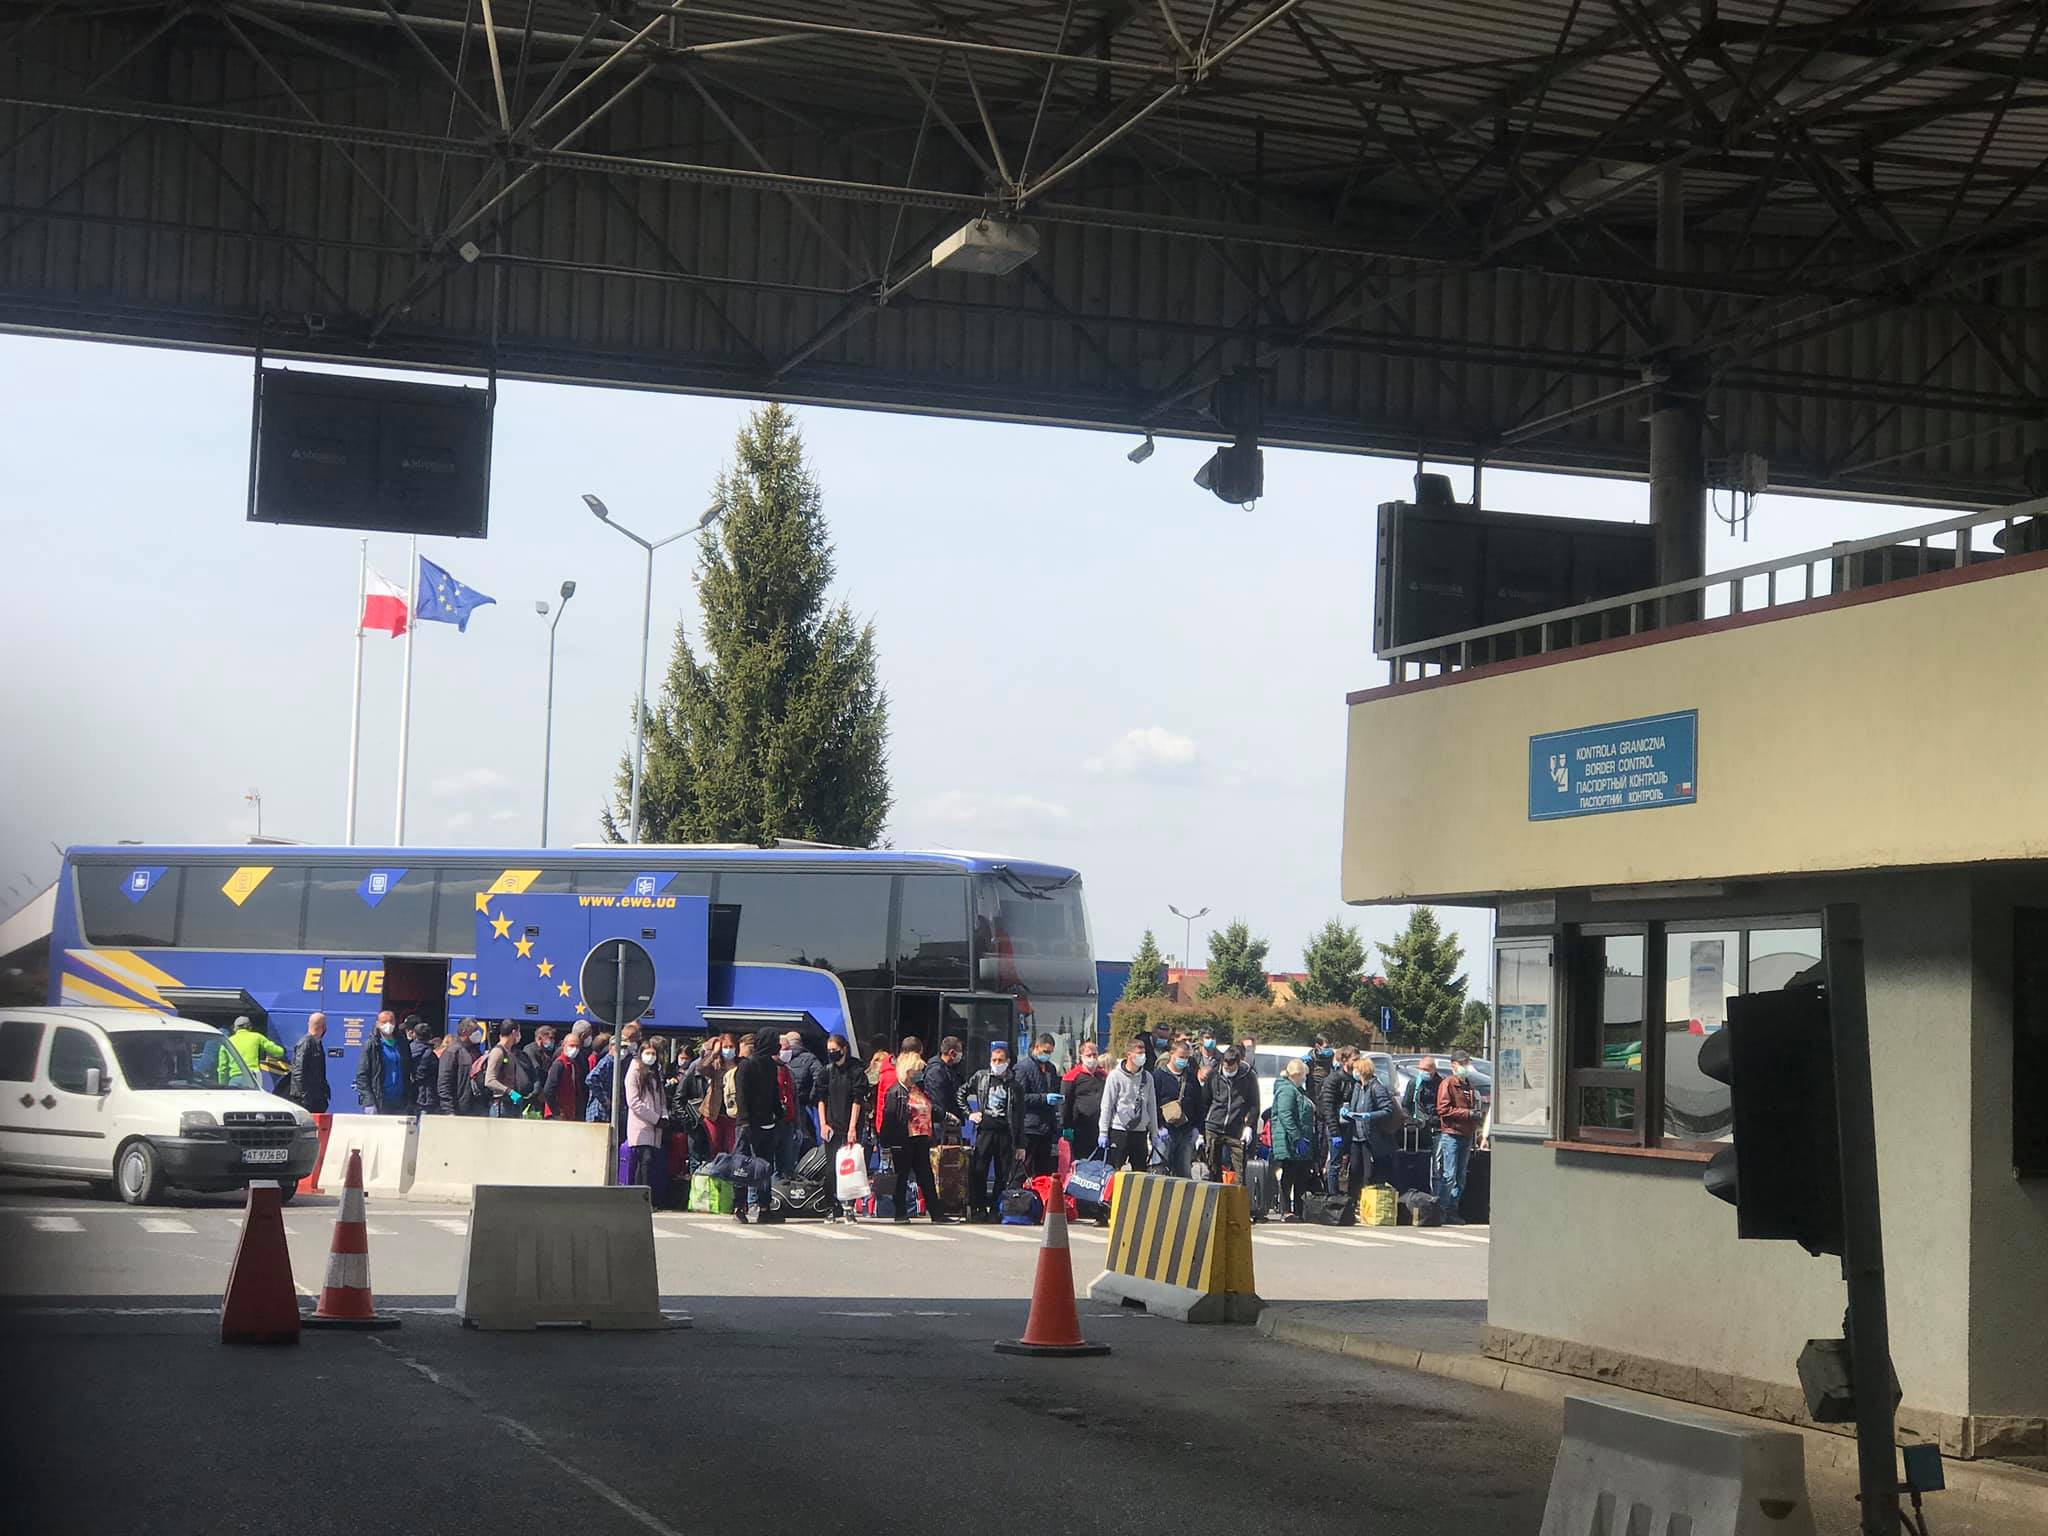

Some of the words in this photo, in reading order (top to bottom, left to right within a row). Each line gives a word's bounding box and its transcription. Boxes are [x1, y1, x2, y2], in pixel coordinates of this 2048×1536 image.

[1576, 744, 1616, 760] KONTROLA
[1620, 736, 1665, 754] GRANICZNA
[1585, 761, 1615, 776] BORDER
[1618, 755, 1654, 771] CONTROL
[1576, 774, 1627, 793] ПАСПОРТНЫЙ
[1629, 771, 1668, 787] КОНТРОЛЬ
[1580, 791, 1622, 808] ПАСПОРТНИЙ
[1628, 788, 1663, 802] КОНТРОЛЬ
[579, 896, 677, 908] www.ewe.ua
